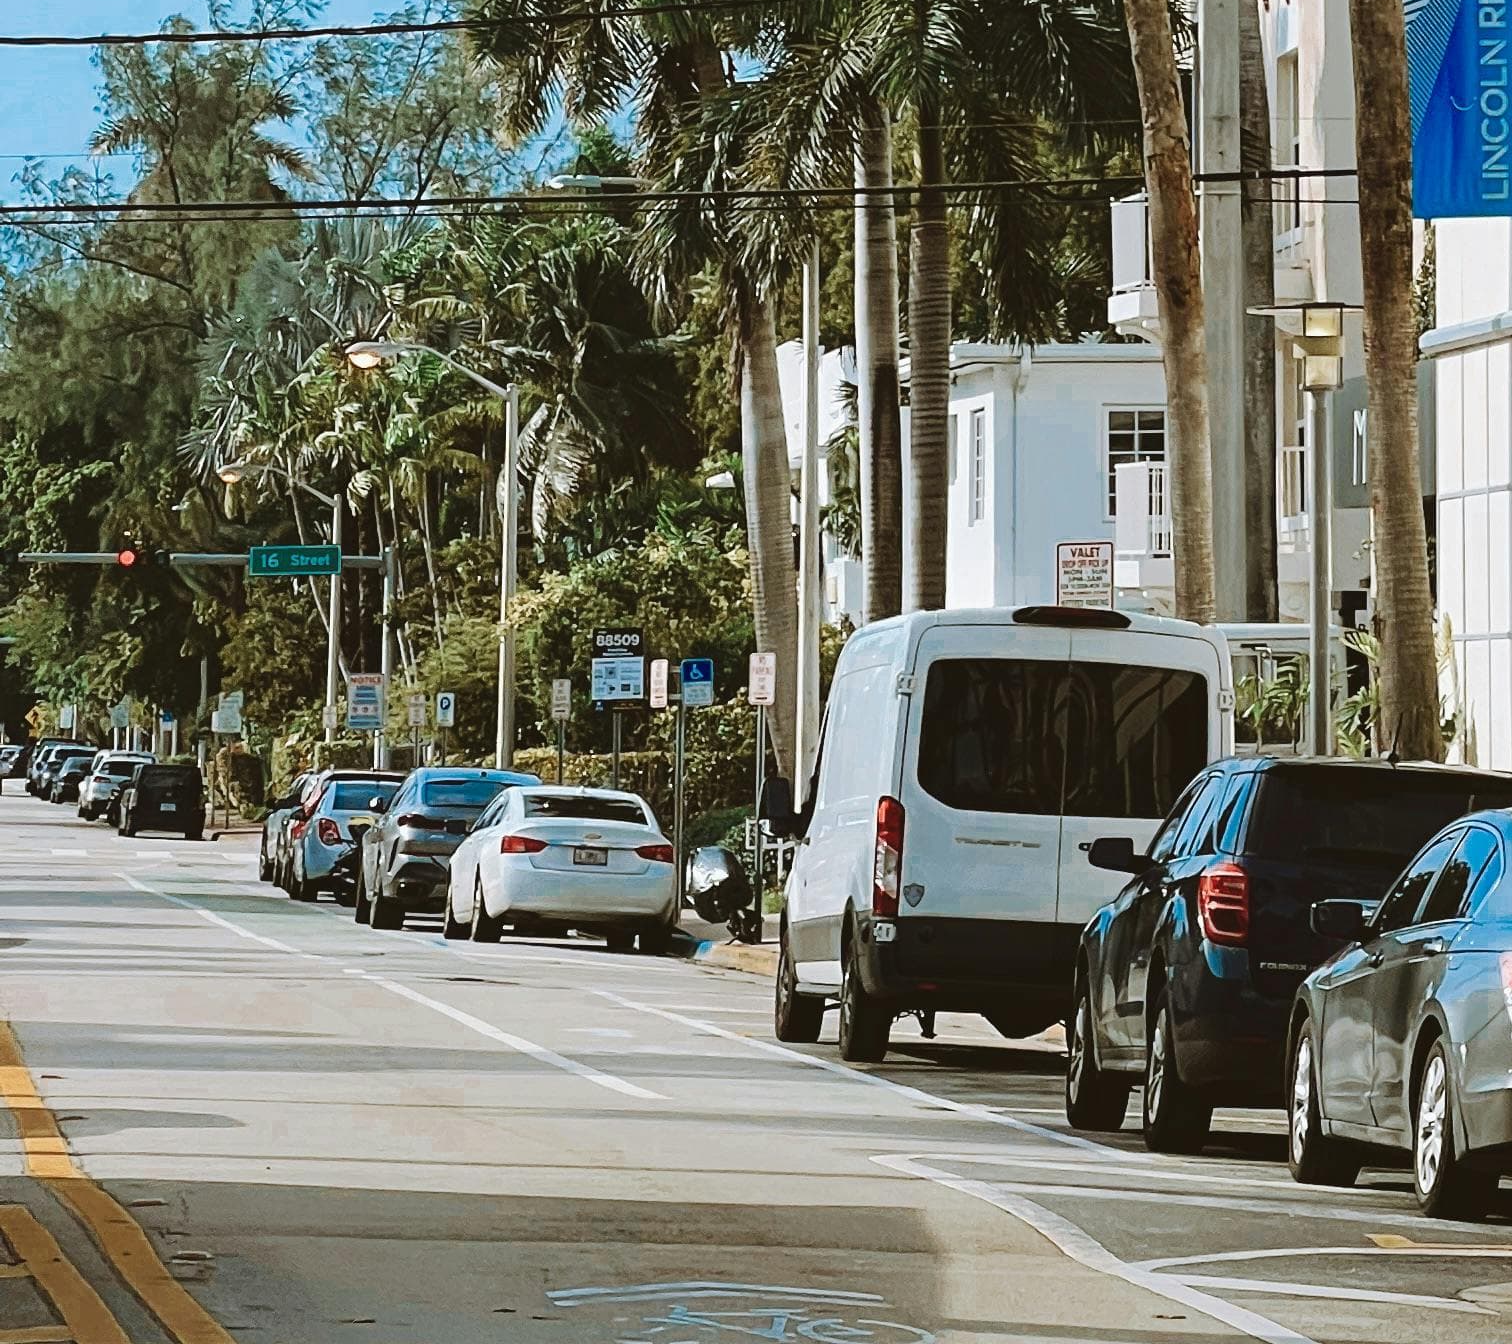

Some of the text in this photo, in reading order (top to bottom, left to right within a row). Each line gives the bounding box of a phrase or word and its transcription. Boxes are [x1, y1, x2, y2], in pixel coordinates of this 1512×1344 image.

[1480, 39, 1510, 201] LINCOLN
[1070, 547, 1100, 558] VALET
[261, 553, 330, 568] 16 Street
[596, 634, 640, 647] 88509
[350, 676, 382, 685] NOTICE
